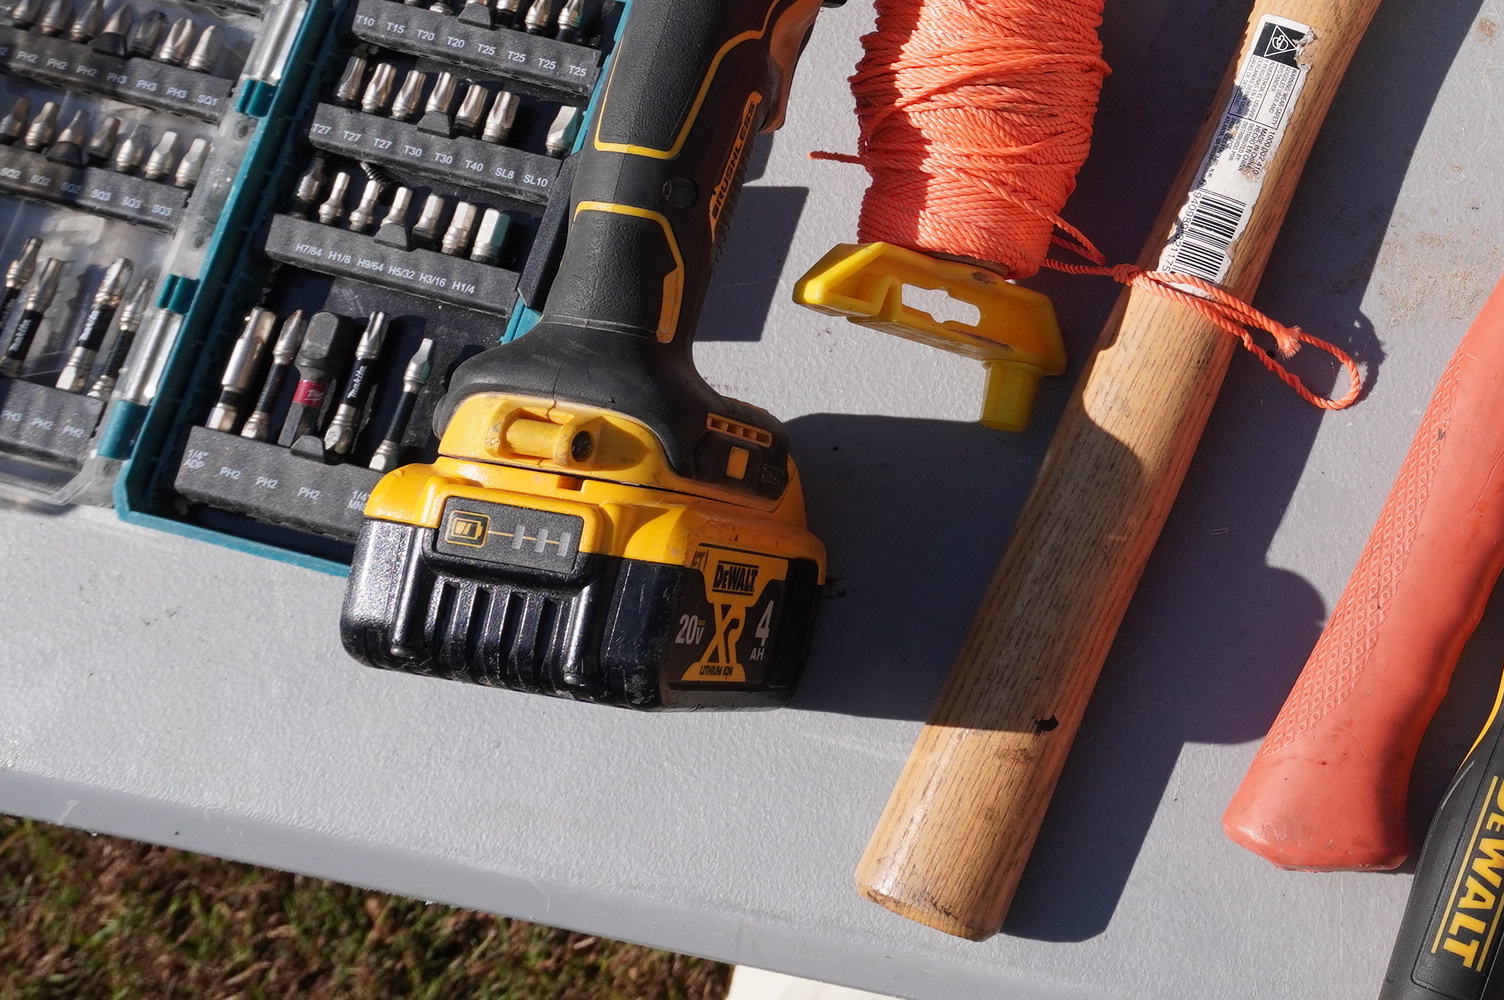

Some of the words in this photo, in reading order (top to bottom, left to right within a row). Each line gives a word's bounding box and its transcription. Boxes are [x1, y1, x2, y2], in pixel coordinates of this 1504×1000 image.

[356, 16, 374, 27] T10
[386, 22, 405, 34] T15
[417, 30, 435, 41] T20
[447, 37, 465, 49] T20
[477, 44, 496, 56] T25
[508, 51, 526, 63] T25
[538, 58, 556, 70] T25
[568, 65, 587, 77] T25
[16, 51, 39, 64] PH2
[46, 57, 69, 70] PH2
[76, 64, 99, 78] PH2
[107, 71, 129, 85] PH3
[136, 78, 159, 92] PH3
[167, 86, 189, 99] PH3
[197, 92, 219, 107] SQ1
[1270, 105, 1282, 126] SAFETY
[1248, 124, 1260, 145] HECHO
[1256, 127, 1267, 145] MADE
[1263, 130, 1275, 148] 1000
[312, 123, 331, 136] T27
[342, 130, 362, 142] T27
[373, 138, 392, 150] T27
[404, 144, 422, 158] T30
[434, 152, 453, 165] T30
[465, 160, 484, 172] T40
[494, 167, 514, 180] SL8
[523, 174, 548, 188] SL10
[711, 99, 756, 219] BRUSHLESS
[1245, 151, 1257, 169] CHINA
[295, 243, 322, 258] H7/64
[328, 250, 351, 264] H1/8
[357, 258, 384, 272] H9/64
[388, 265, 415, 280] H5/32
[419, 272, 446, 288] H3/16
[451, 280, 476, 294] H1/4
[220, 467, 242, 480] PH2
[256, 476, 279, 489] PH2
[298, 486, 321, 501] PH2
[755, 600, 774, 646] 4
[750, 648, 765, 660] AH
[699, 665, 723, 676] LITHIUM
